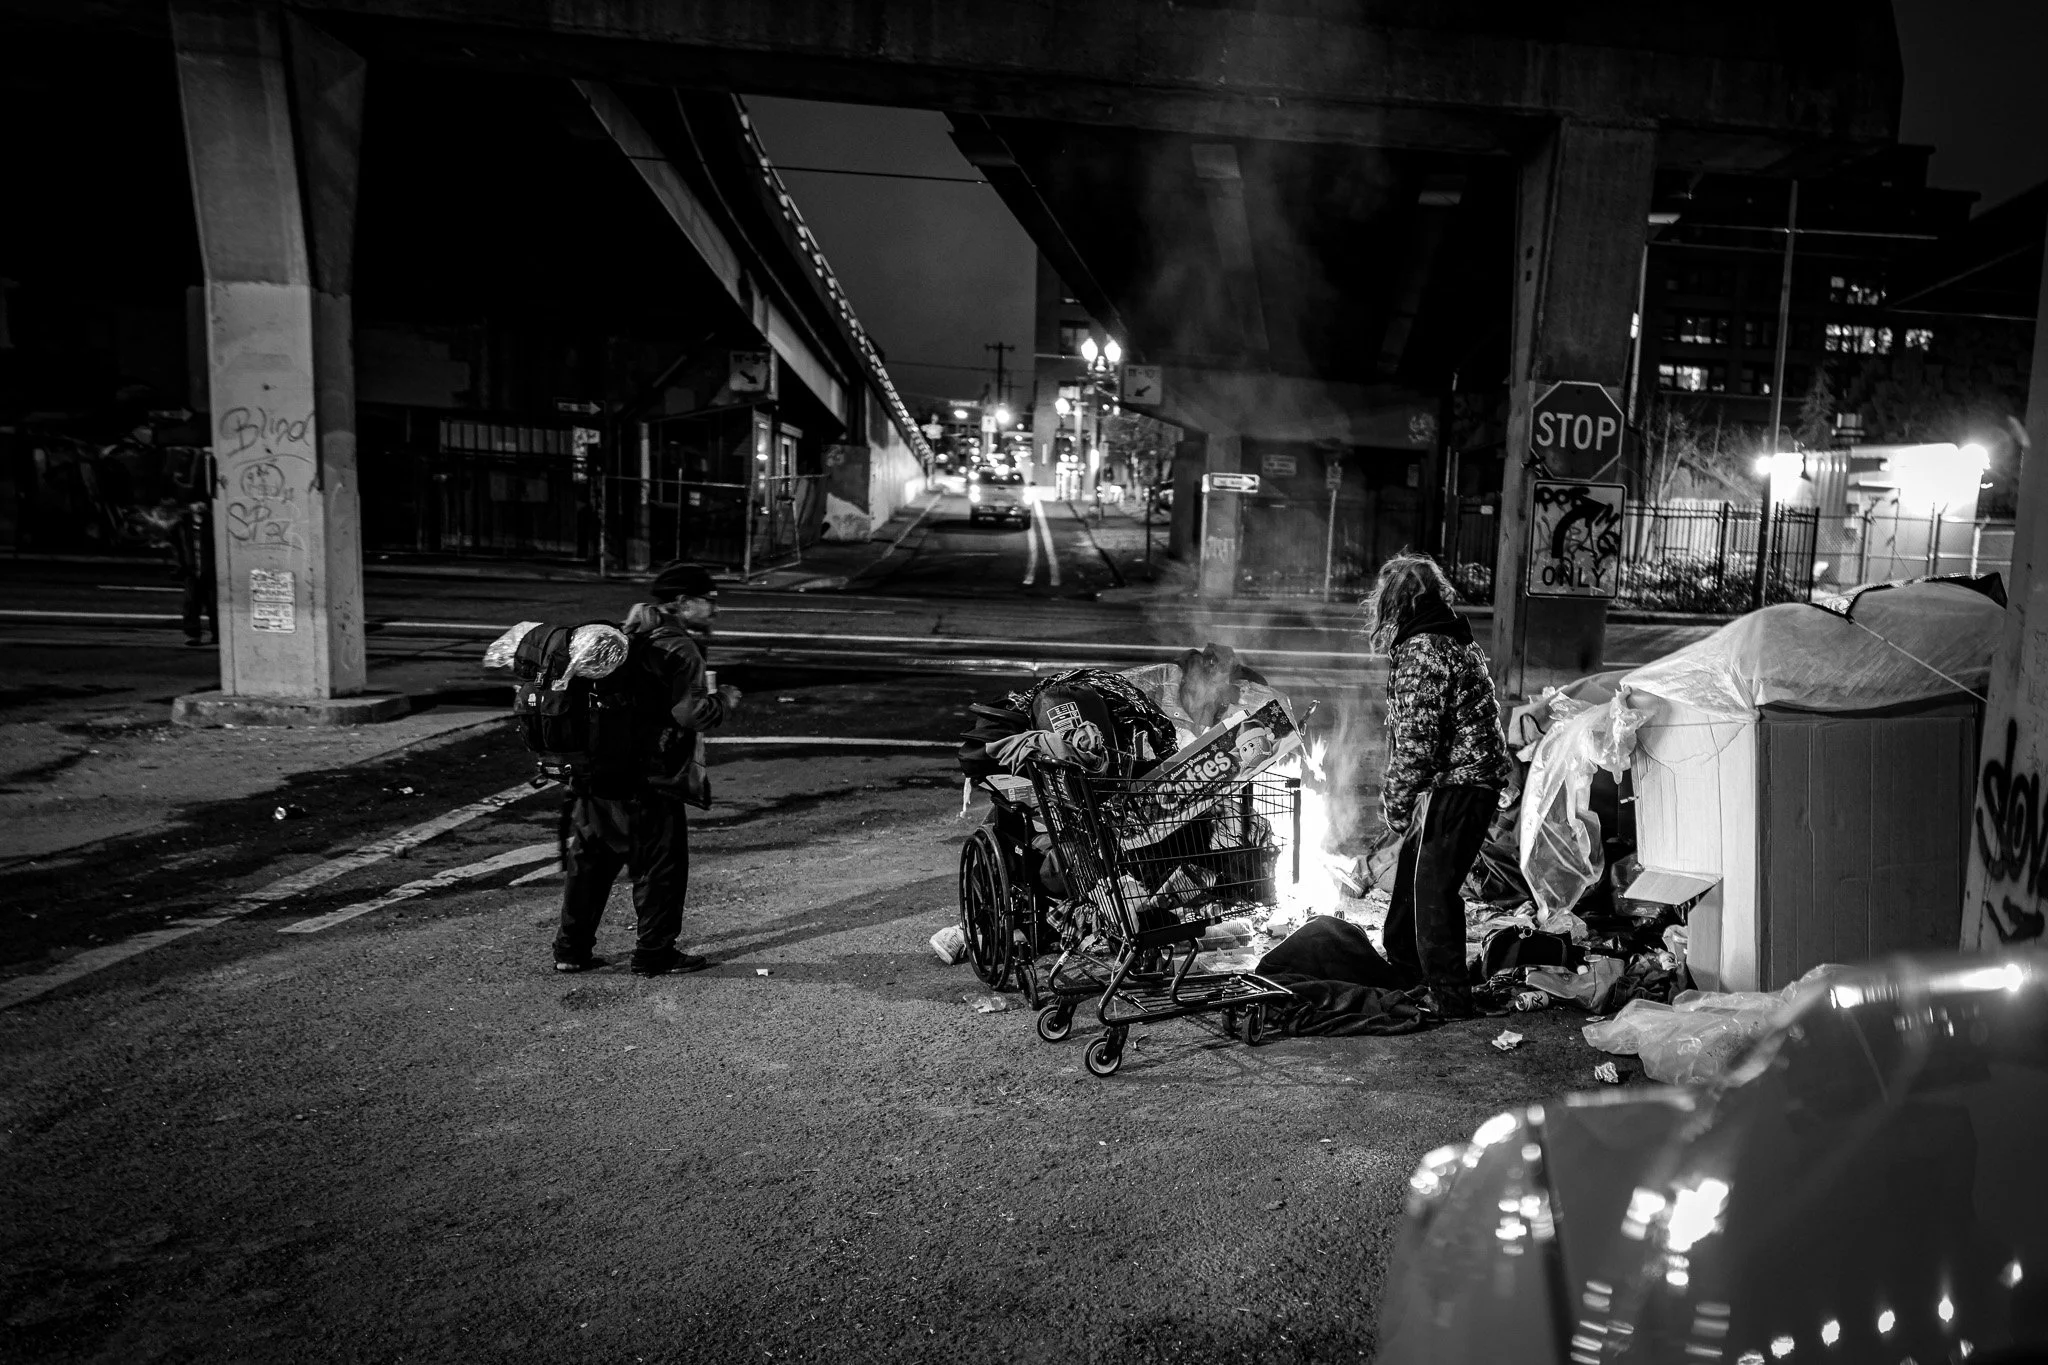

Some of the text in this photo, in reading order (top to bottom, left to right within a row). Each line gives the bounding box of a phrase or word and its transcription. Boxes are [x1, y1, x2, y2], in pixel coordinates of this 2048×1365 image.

[1536, 411, 1616, 450] STOP
[1542, 565, 1606, 588] ONLY
[1155, 751, 1232, 811] Cuties
